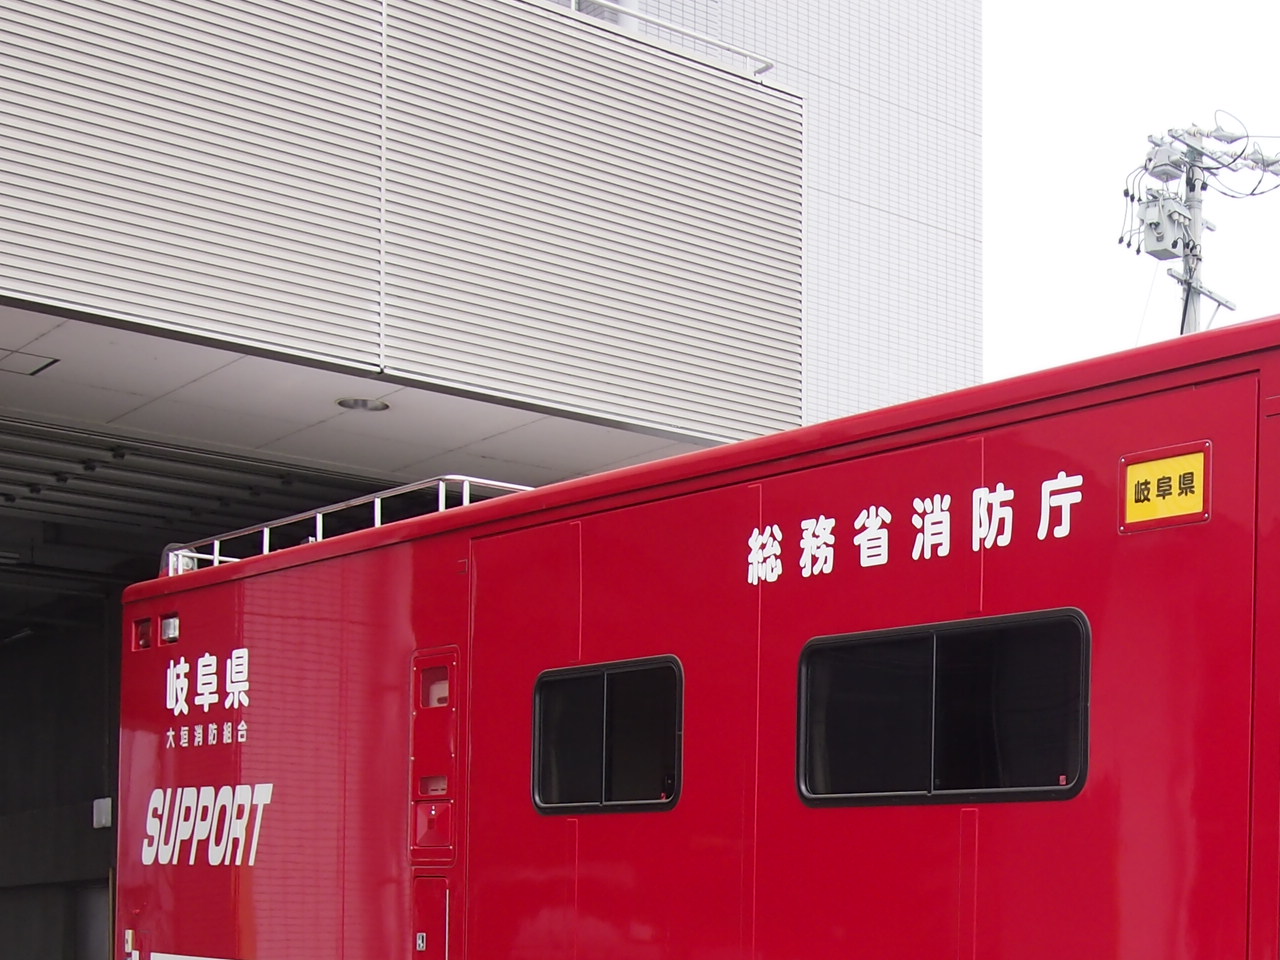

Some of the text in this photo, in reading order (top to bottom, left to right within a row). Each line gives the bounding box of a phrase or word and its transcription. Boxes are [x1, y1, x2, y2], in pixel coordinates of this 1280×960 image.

[1133, 471, 1196, 504] 岐阜県
[747, 470, 1083, 586] 総務省消防庁
[165, 647, 250, 717] 岐阜県
[165, 719, 249, 749] 大垣消防組合
[141, 783, 274, 866] SUPPORT
